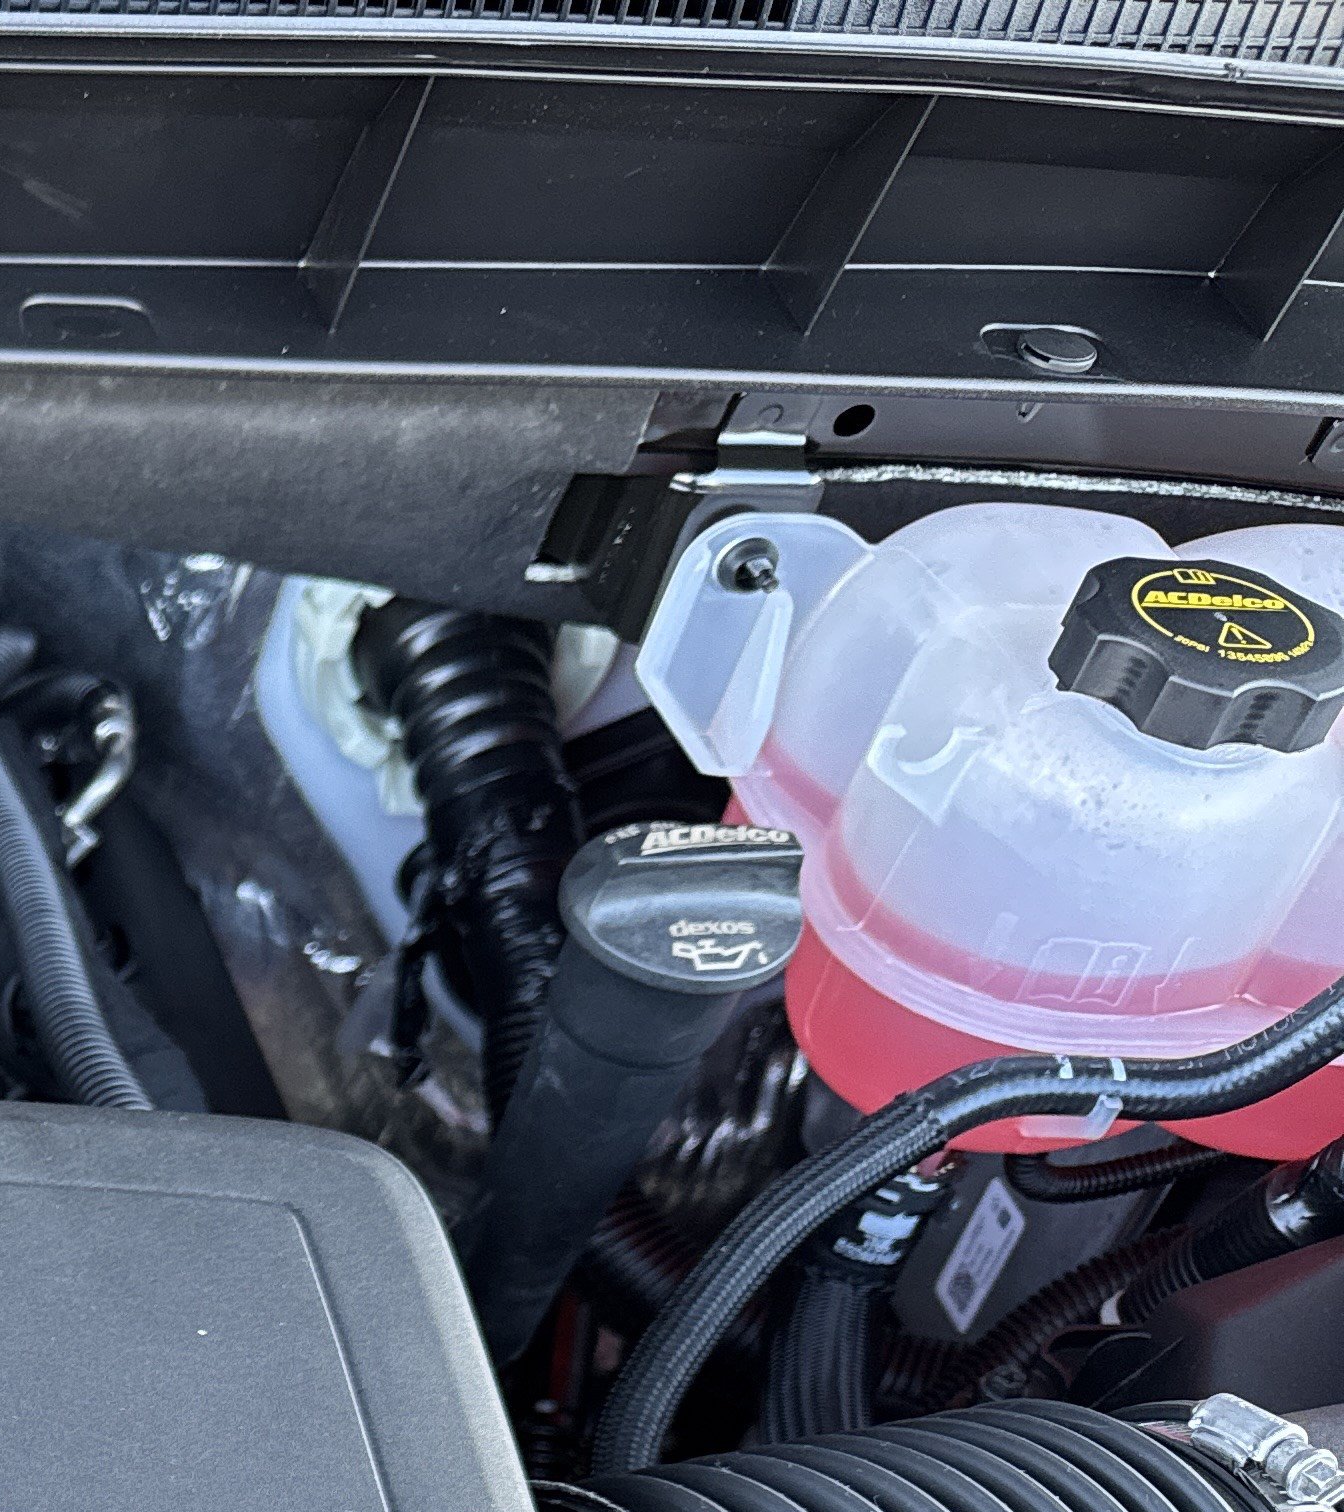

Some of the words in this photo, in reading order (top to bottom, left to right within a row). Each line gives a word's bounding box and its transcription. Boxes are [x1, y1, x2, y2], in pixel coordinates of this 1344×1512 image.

[1143, 590, 1286, 609] ACDelco
[641, 825, 790, 850] ACDelco
[668, 918, 756, 938] dexos
